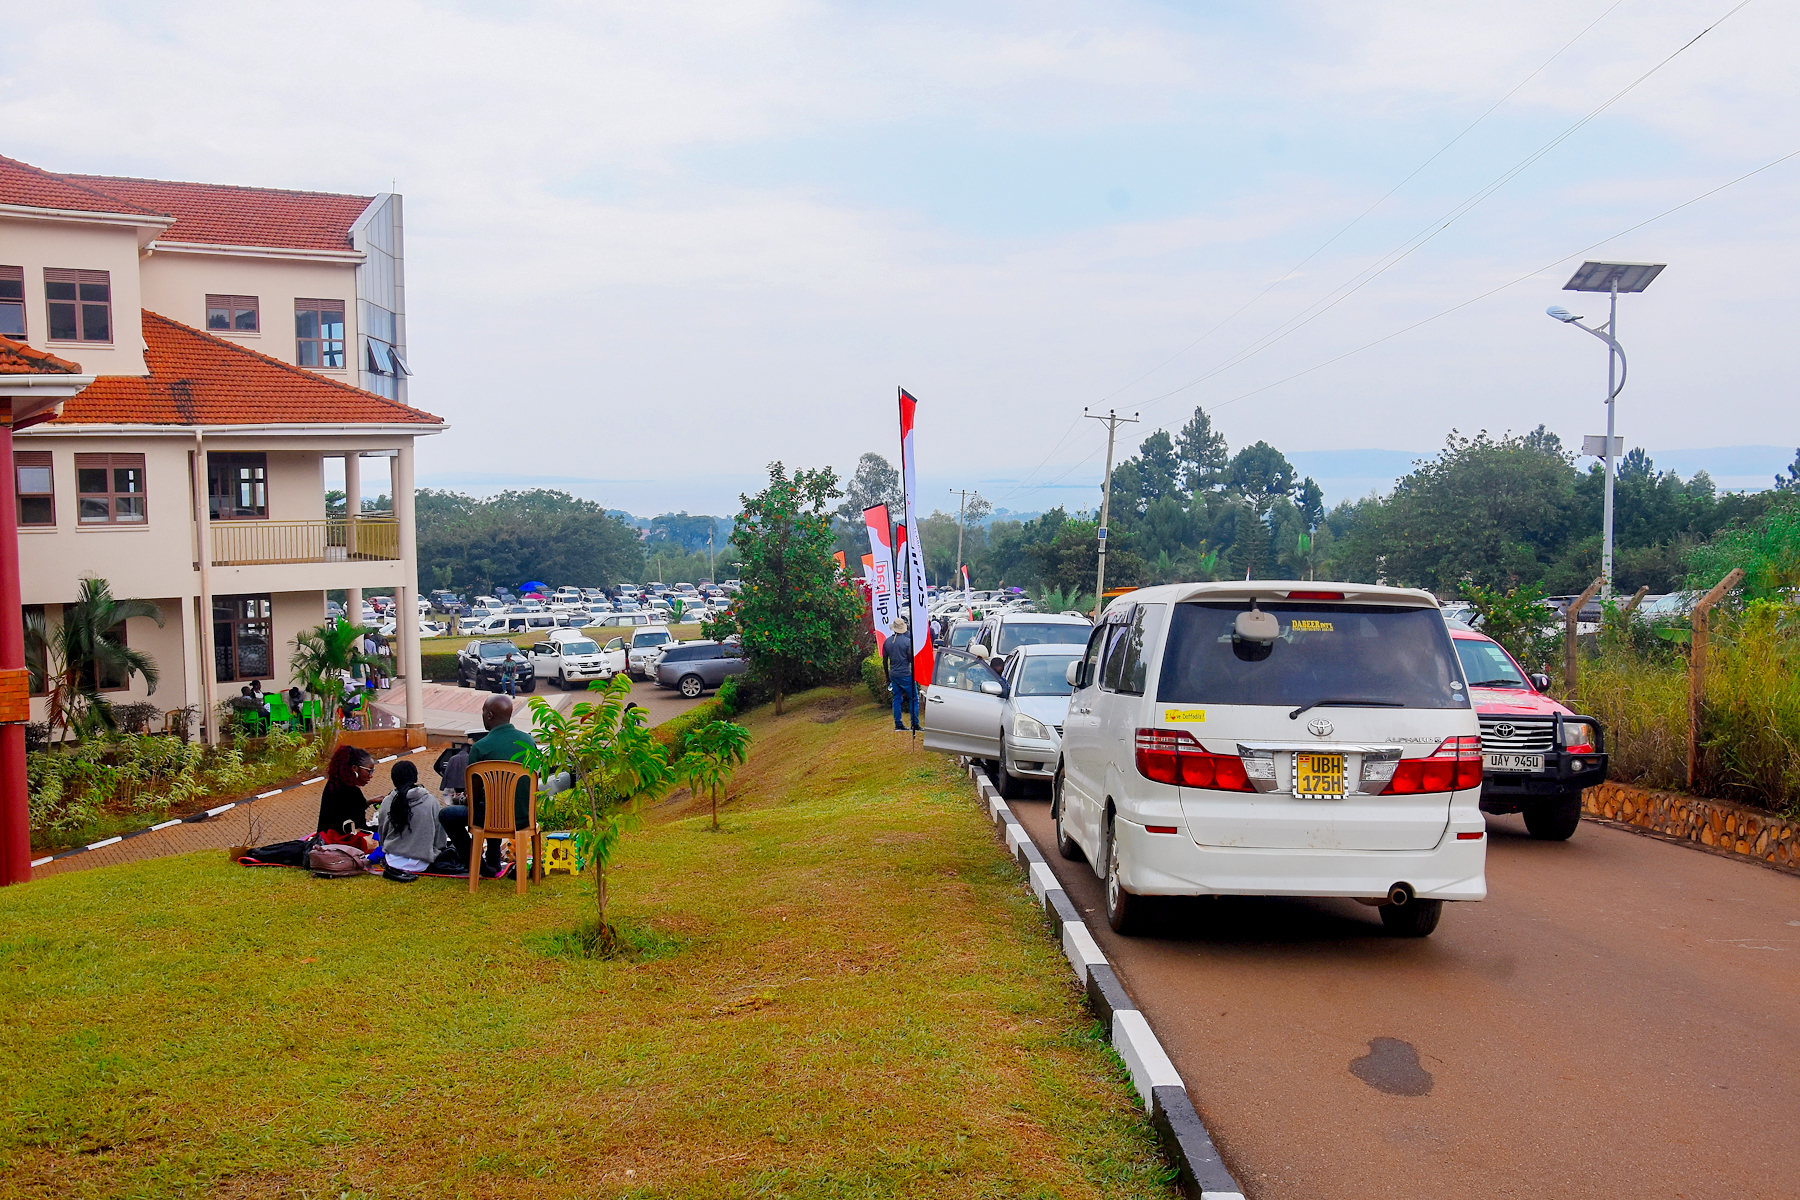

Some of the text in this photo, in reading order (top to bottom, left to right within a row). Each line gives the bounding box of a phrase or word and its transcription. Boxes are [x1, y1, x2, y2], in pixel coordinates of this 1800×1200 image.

[1311, 757, 1341, 773] UBH
[1491, 755, 1538, 767] UAY 945U
[1303, 775, 1341, 792] 175H
